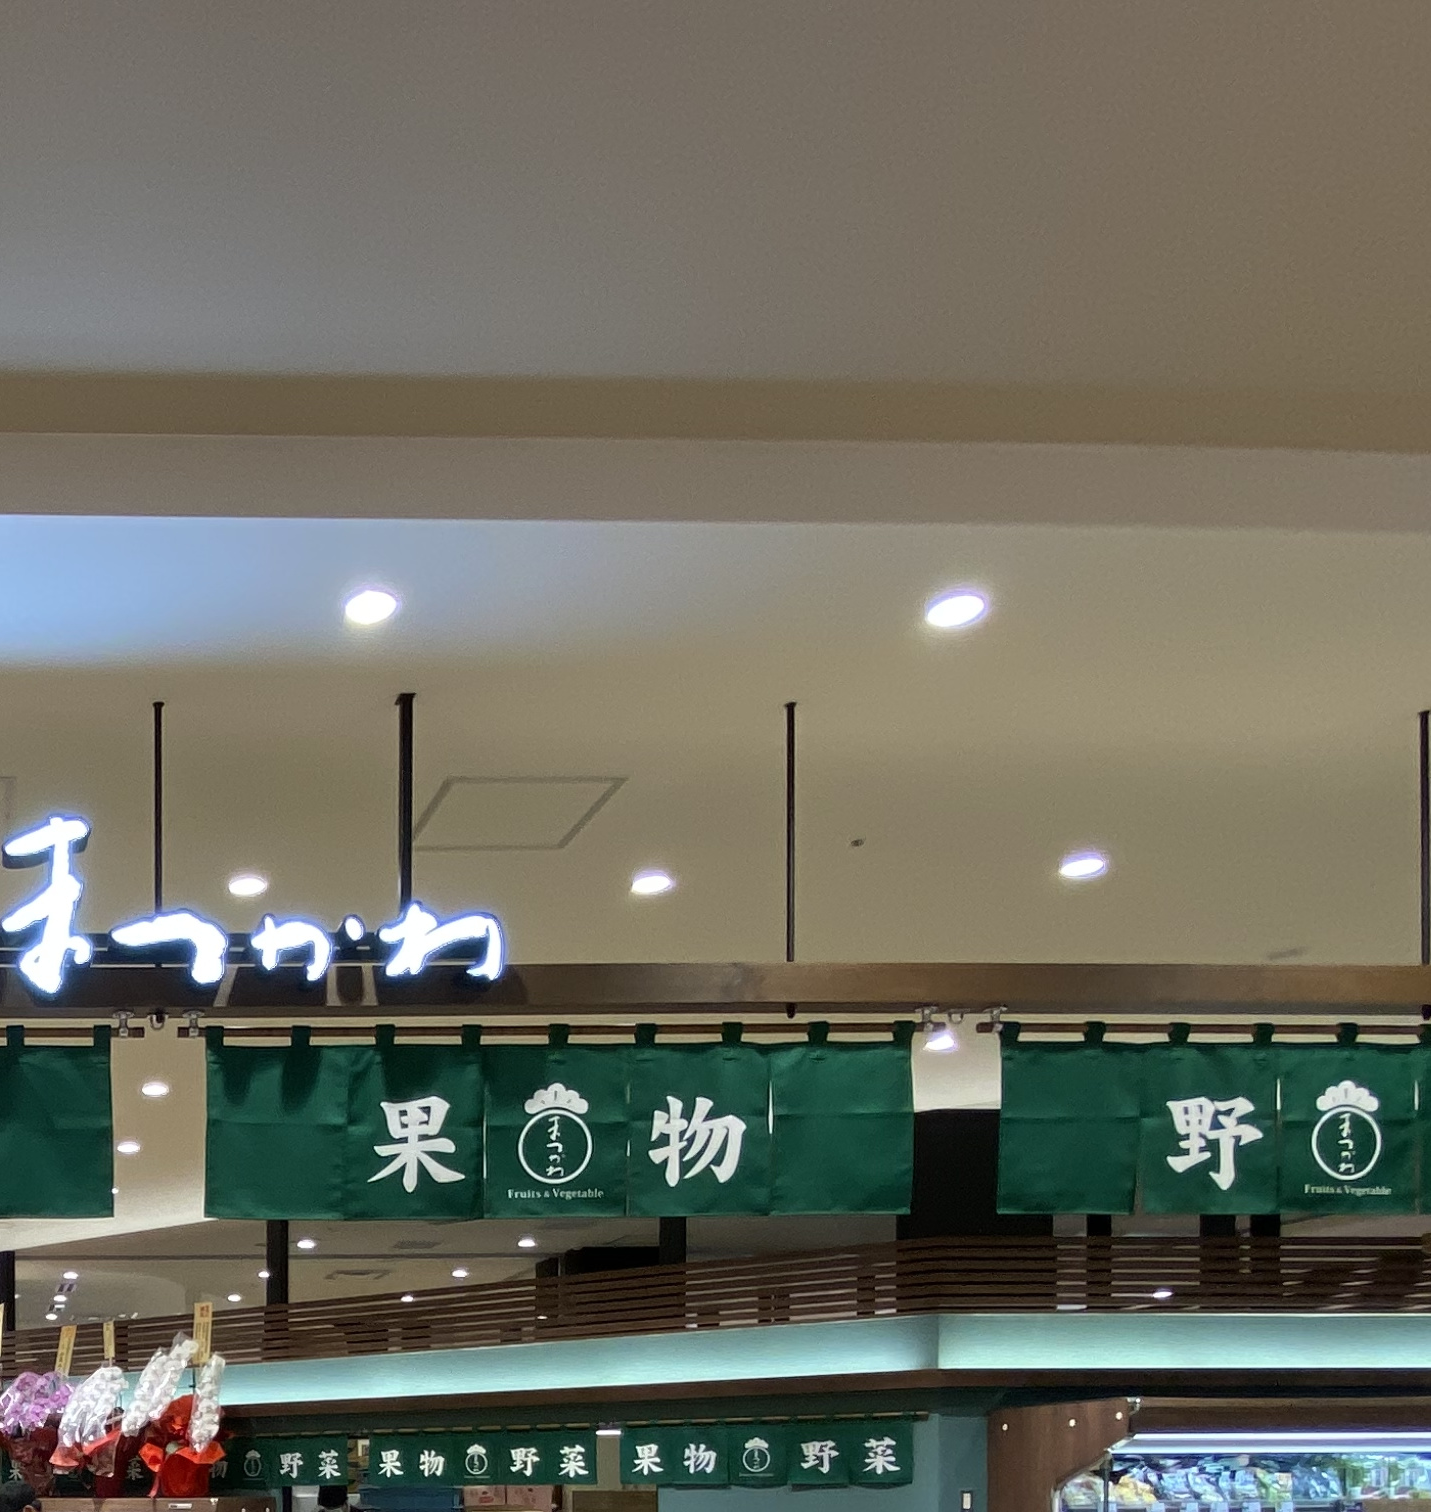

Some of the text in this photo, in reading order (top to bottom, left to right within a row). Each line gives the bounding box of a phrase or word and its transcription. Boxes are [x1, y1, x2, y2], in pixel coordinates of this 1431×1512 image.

[2, 815, 505, 993] まつかわ
[1166, 1096, 1264, 1191] 野
[507, 1188, 542, 1199] Fruits
[552, 1188, 604, 1200] Vegetable
